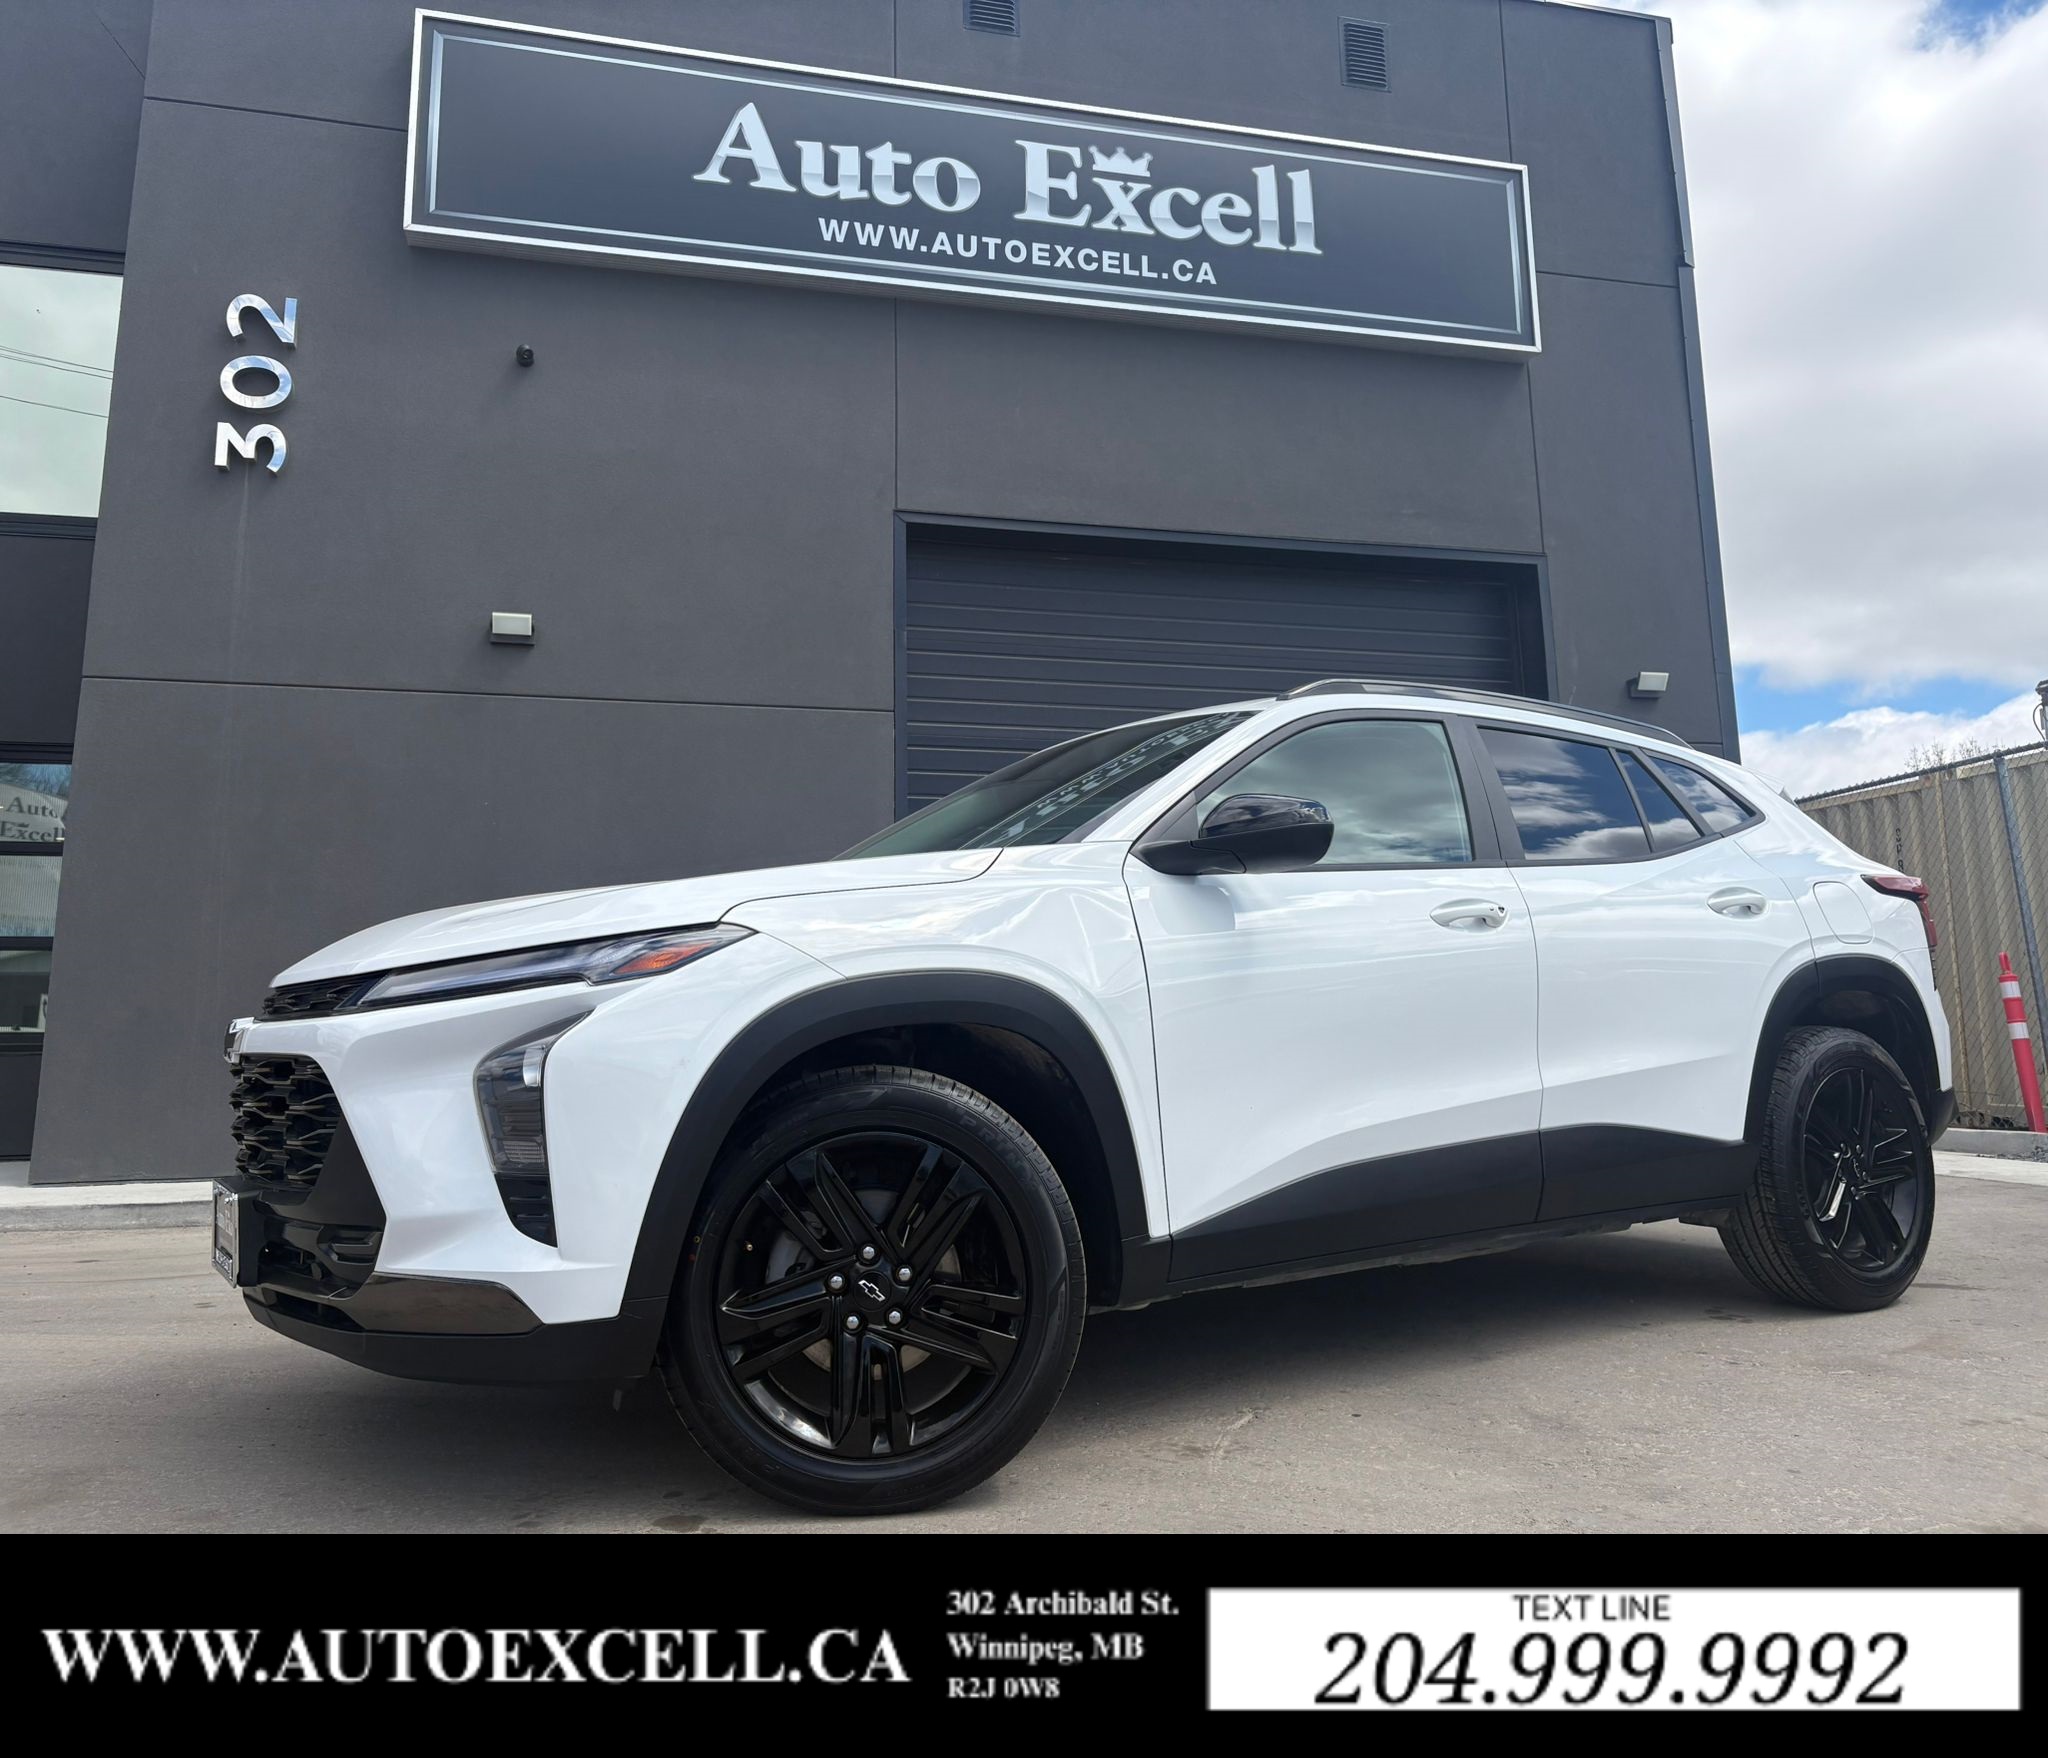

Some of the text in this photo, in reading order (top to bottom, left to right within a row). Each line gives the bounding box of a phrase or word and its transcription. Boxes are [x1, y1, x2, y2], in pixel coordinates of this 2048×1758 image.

[692, 102, 1323, 255] Auto Excell
[818, 217, 1217, 285] WWW.AUTOEXCELL.CA
[214, 293, 298, 473] 302
[0, 821, 65, 841] Excell
[6, 796, 59, 819] Auto
